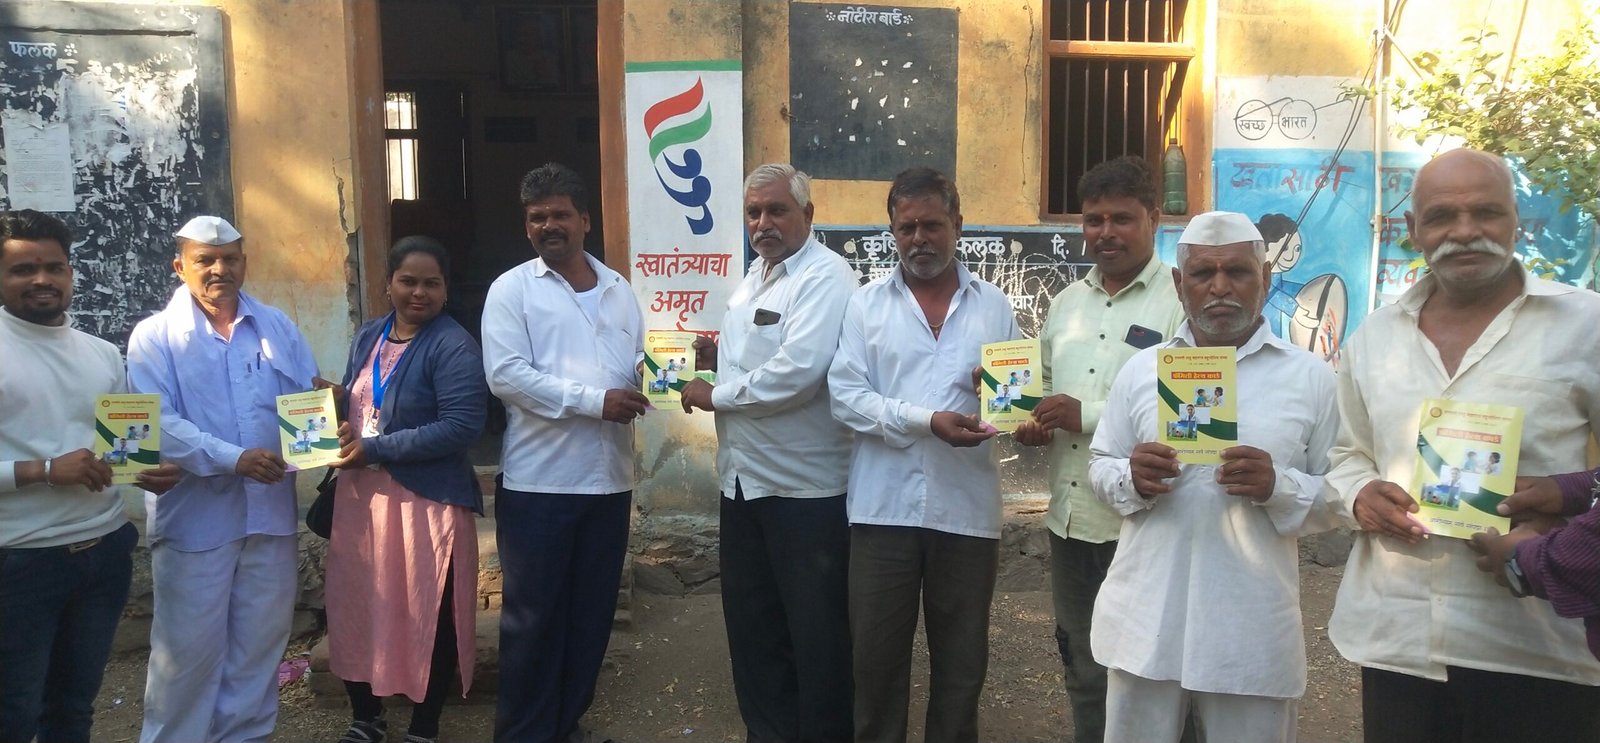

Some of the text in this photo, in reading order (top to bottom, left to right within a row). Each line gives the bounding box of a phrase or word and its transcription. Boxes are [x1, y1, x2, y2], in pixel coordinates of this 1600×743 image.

[8, 41, 57, 59] फलक
[1281, 116, 1308, 128] भारत
[650, 291, 709, 322] अमृत
